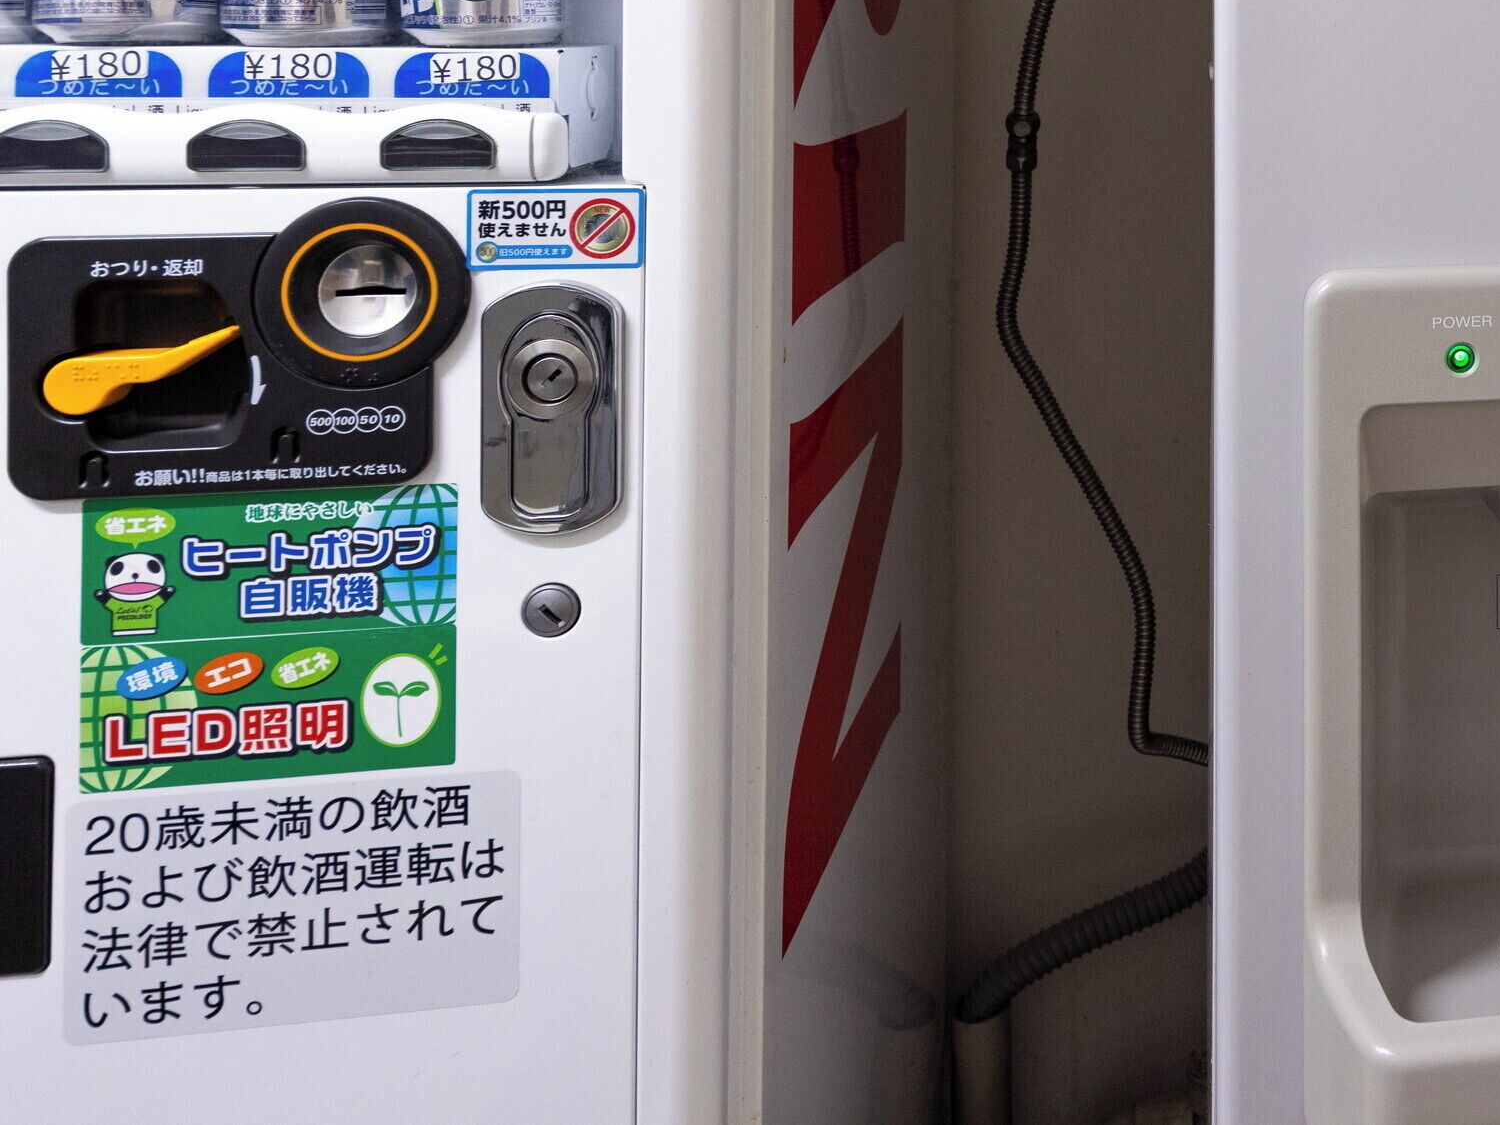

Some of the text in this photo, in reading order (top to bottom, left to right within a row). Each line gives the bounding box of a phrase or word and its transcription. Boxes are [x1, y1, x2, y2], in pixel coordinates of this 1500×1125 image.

[51, 51, 141, 80] ¥180
[246, 53, 332, 79] ¥180
[433, 54, 517, 82] ¥180
[478, 200, 566, 220] 新500円
[478, 222, 567, 239] 使えません
[499, 248, 568, 257] 旧500円使えます
[90, 259, 204, 277] おつり・返却
[1432, 315, 1493, 329] POWER
[309, 412, 400, 428] 500 100 50 10
[104, 515, 168, 536] 省エネ
[245, 501, 374, 523] 地球にやさしい
[182, 526, 437, 577] ヒートポンプ
[241, 573, 379, 621] 自販機
[126, 661, 179, 694] 環境
[204, 658, 253, 689] エコ
[277, 652, 331, 685] 省エネ
[105, 700, 350, 762] LED照明
[85, 785, 471, 856] 20歳未満の飲酒
[83, 838, 506, 914] および飲酒運転は
[82, 895, 504, 974] 法律で禁止されて
[83, 975, 263, 1029] います。
